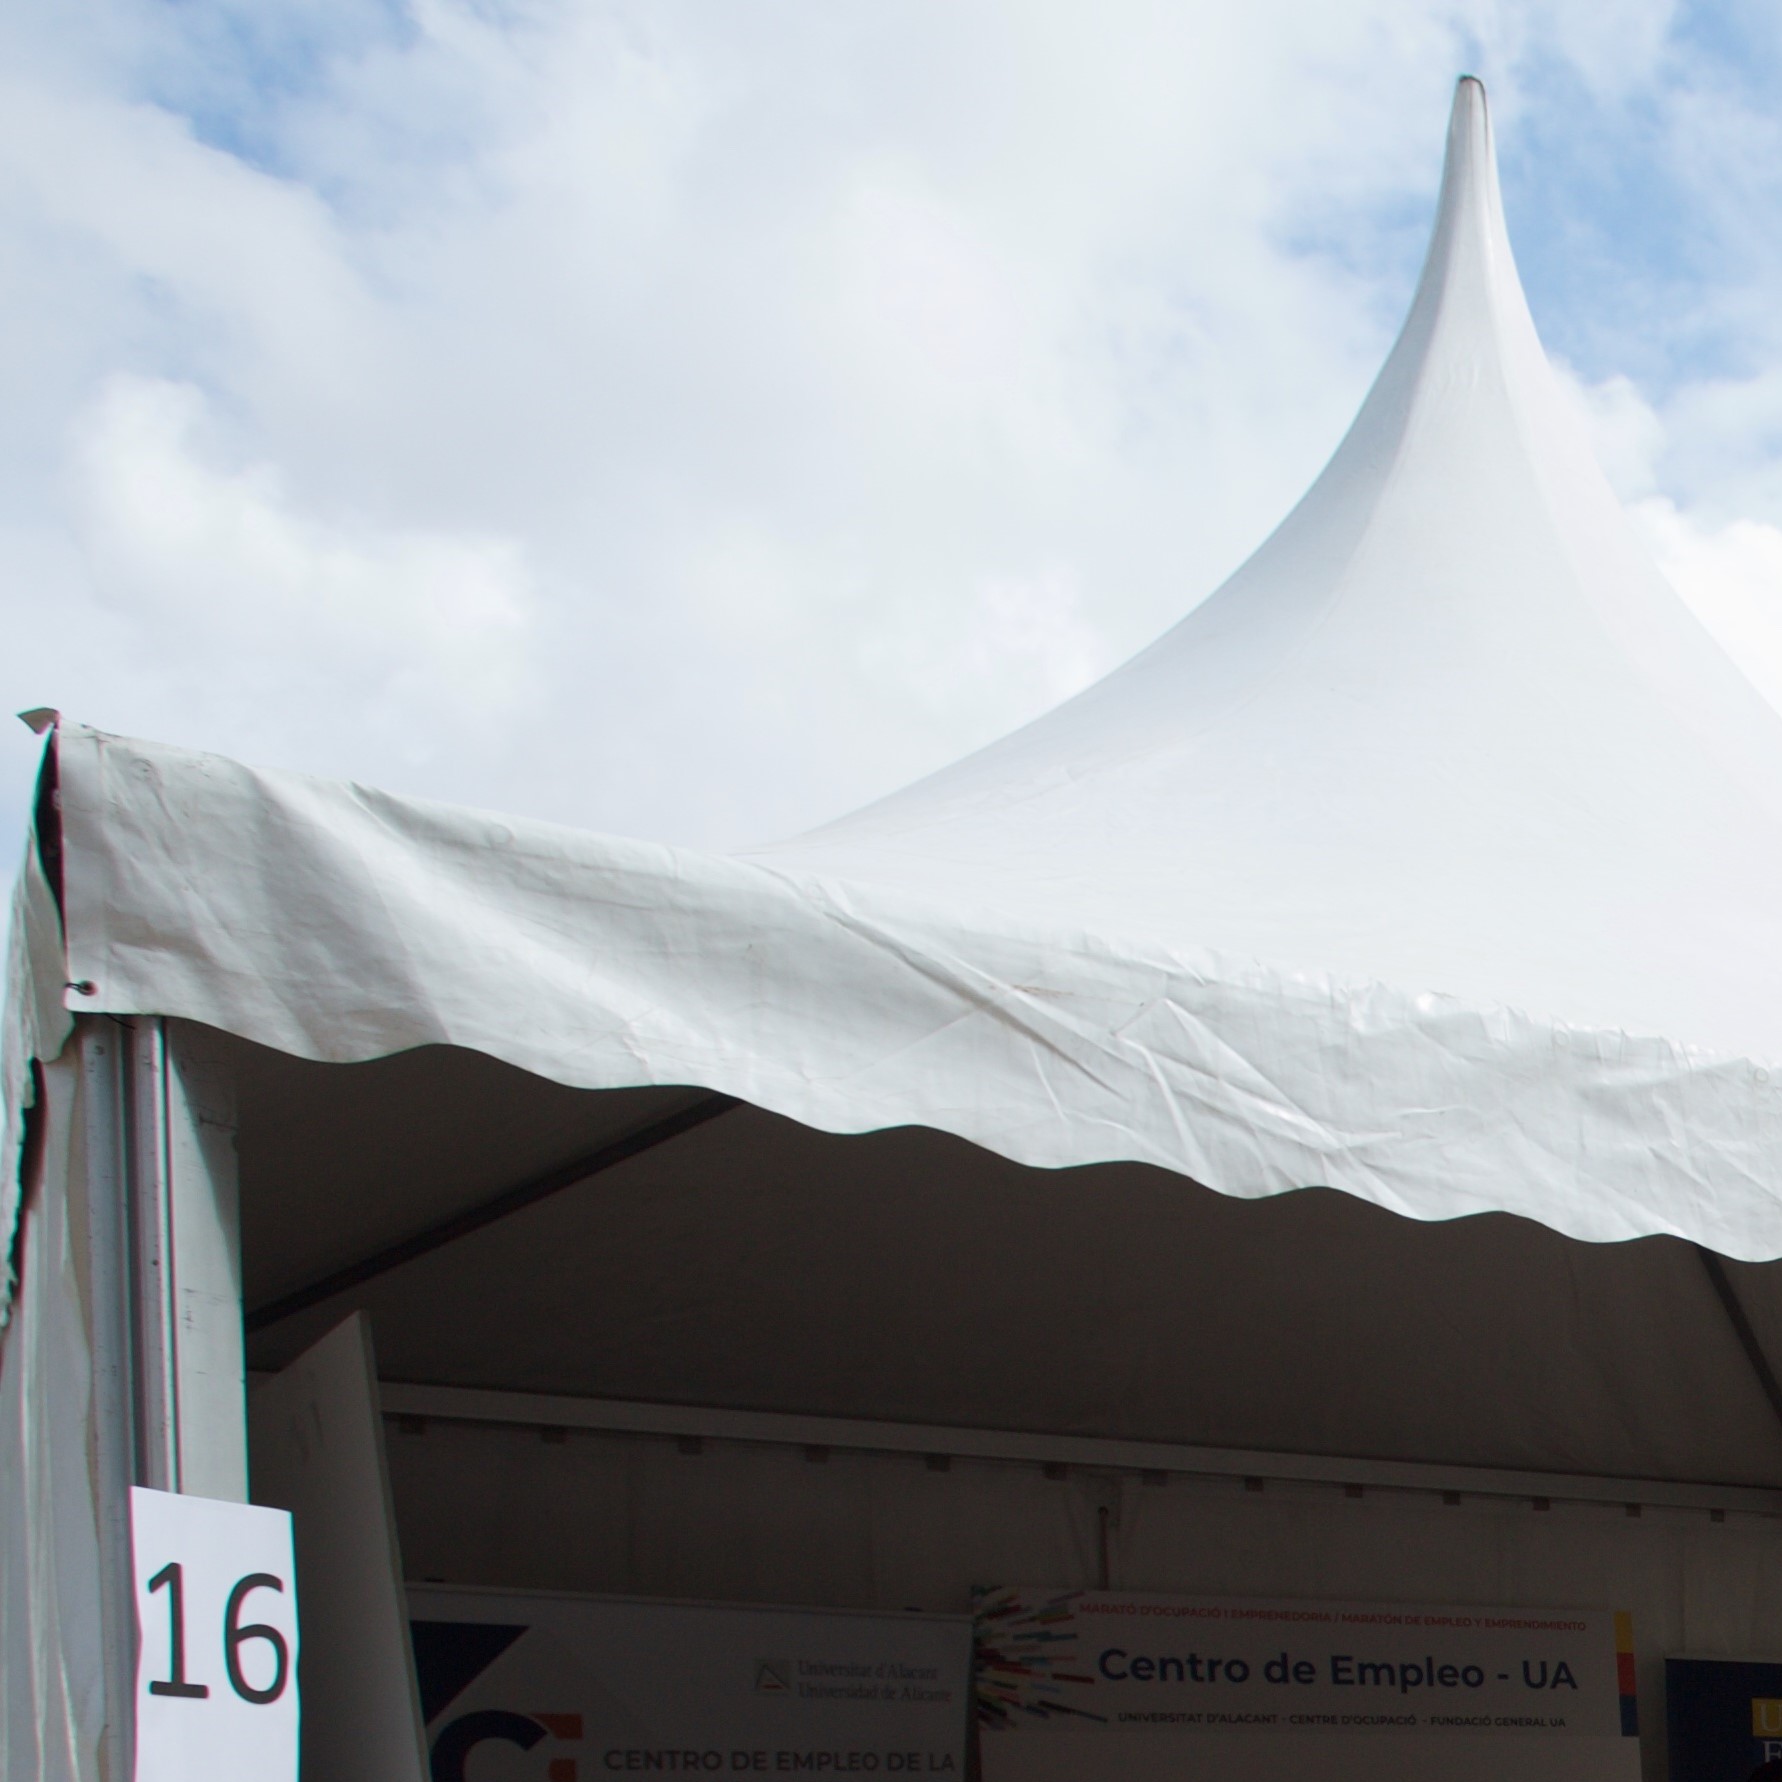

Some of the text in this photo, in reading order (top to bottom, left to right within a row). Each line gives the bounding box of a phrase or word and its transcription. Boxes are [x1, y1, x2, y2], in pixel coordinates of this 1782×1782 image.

[1405, 1616, 1420, 1625] DE
[1424, 1617, 1470, 1627] EMPLEO
[146, 1562, 290, 1706] 16
[1099, 1649, 1578, 1693] Centro de Empleo UA
[1118, 1713, 1202, 1723] UNIVERSITAT
[1289, 1714, 1337, 1725] CENTRE
[1495, 1717, 1547, 1727] GENERAL
[1551, 1718, 1565, 1727] UA
[603, 1749, 955, 1772] CENTRO DE EMPLEO DE LA
